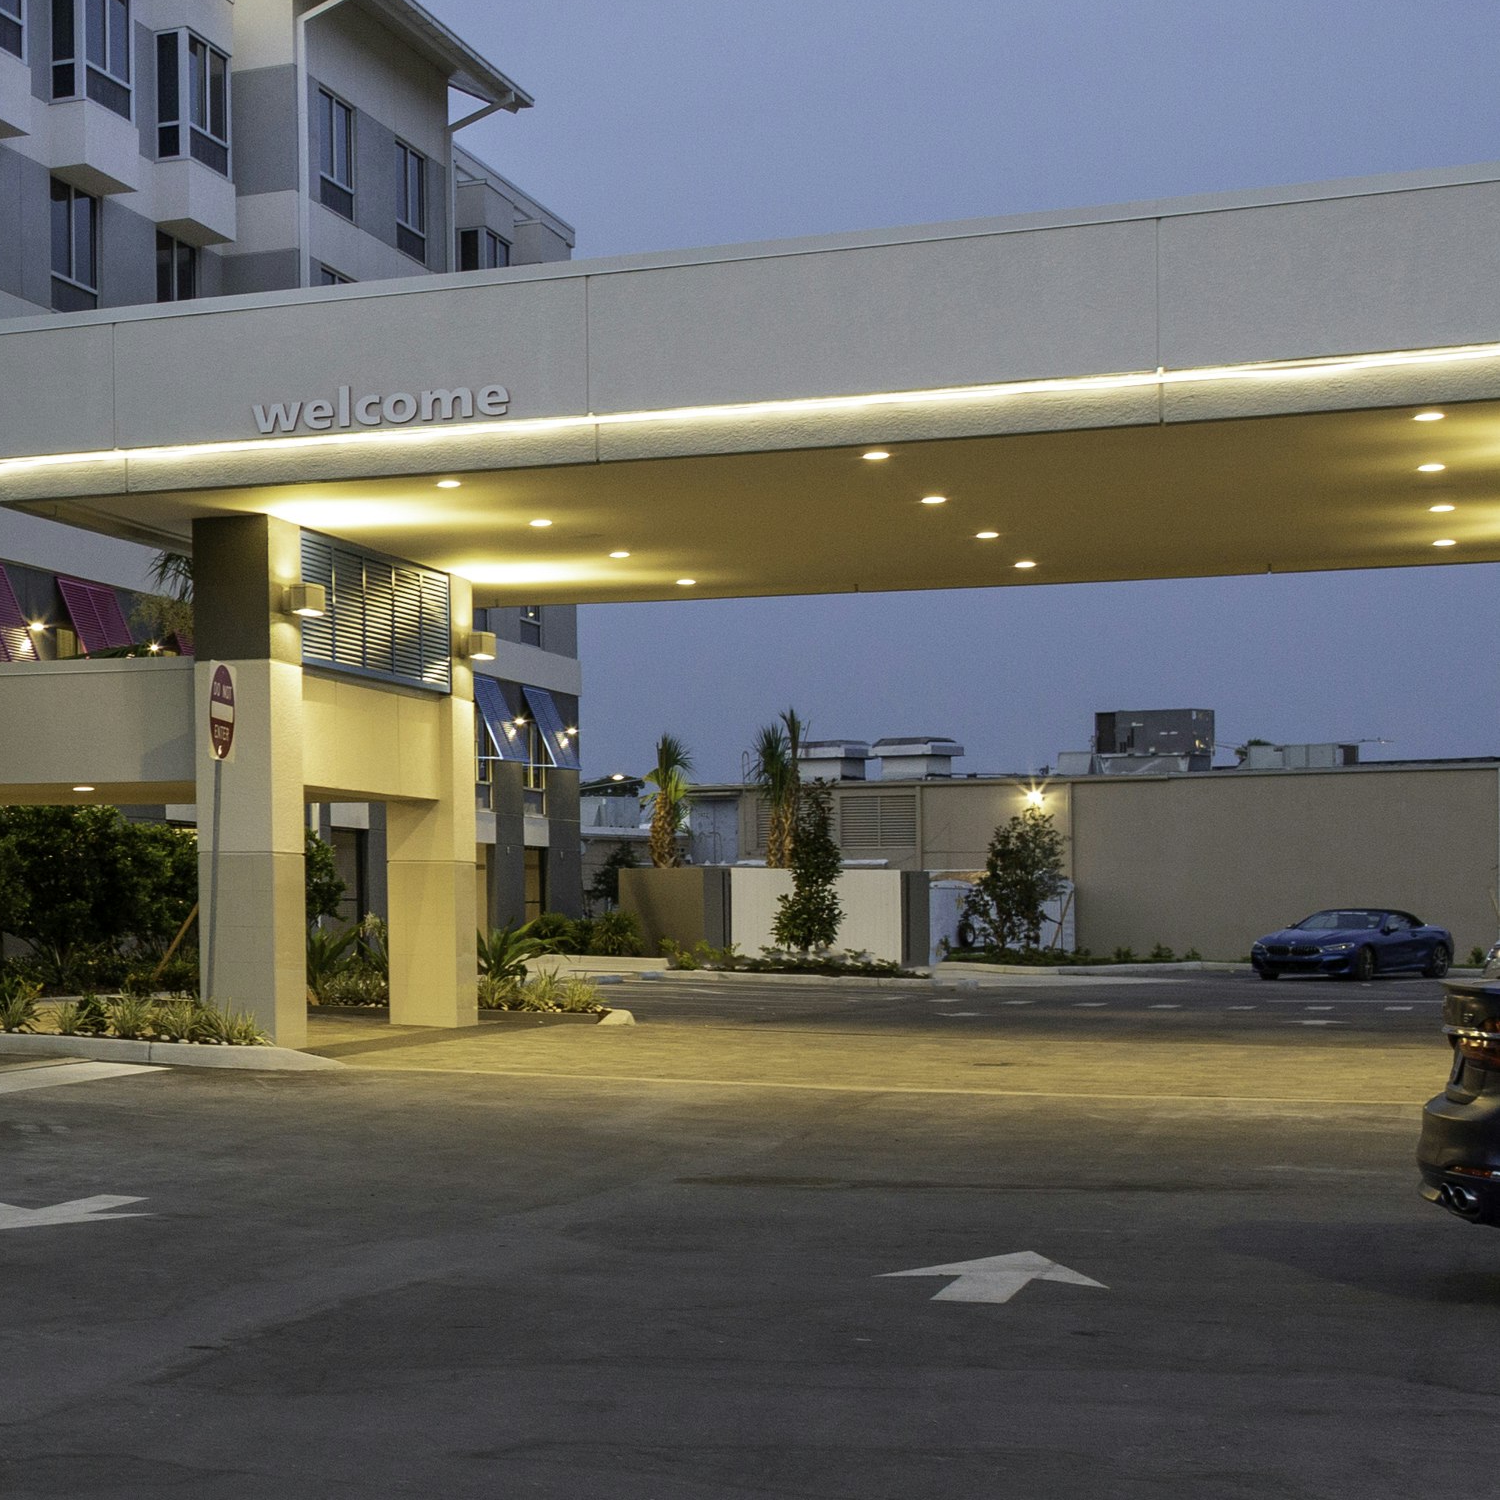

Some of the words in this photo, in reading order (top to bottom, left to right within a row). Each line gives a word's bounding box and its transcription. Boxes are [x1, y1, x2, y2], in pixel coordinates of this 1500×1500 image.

[252, 384, 510, 435] welcome
[213, 681, 221, 697] DO
[222, 684, 232, 700] NOT
[214, 724, 230, 741] ENTER
